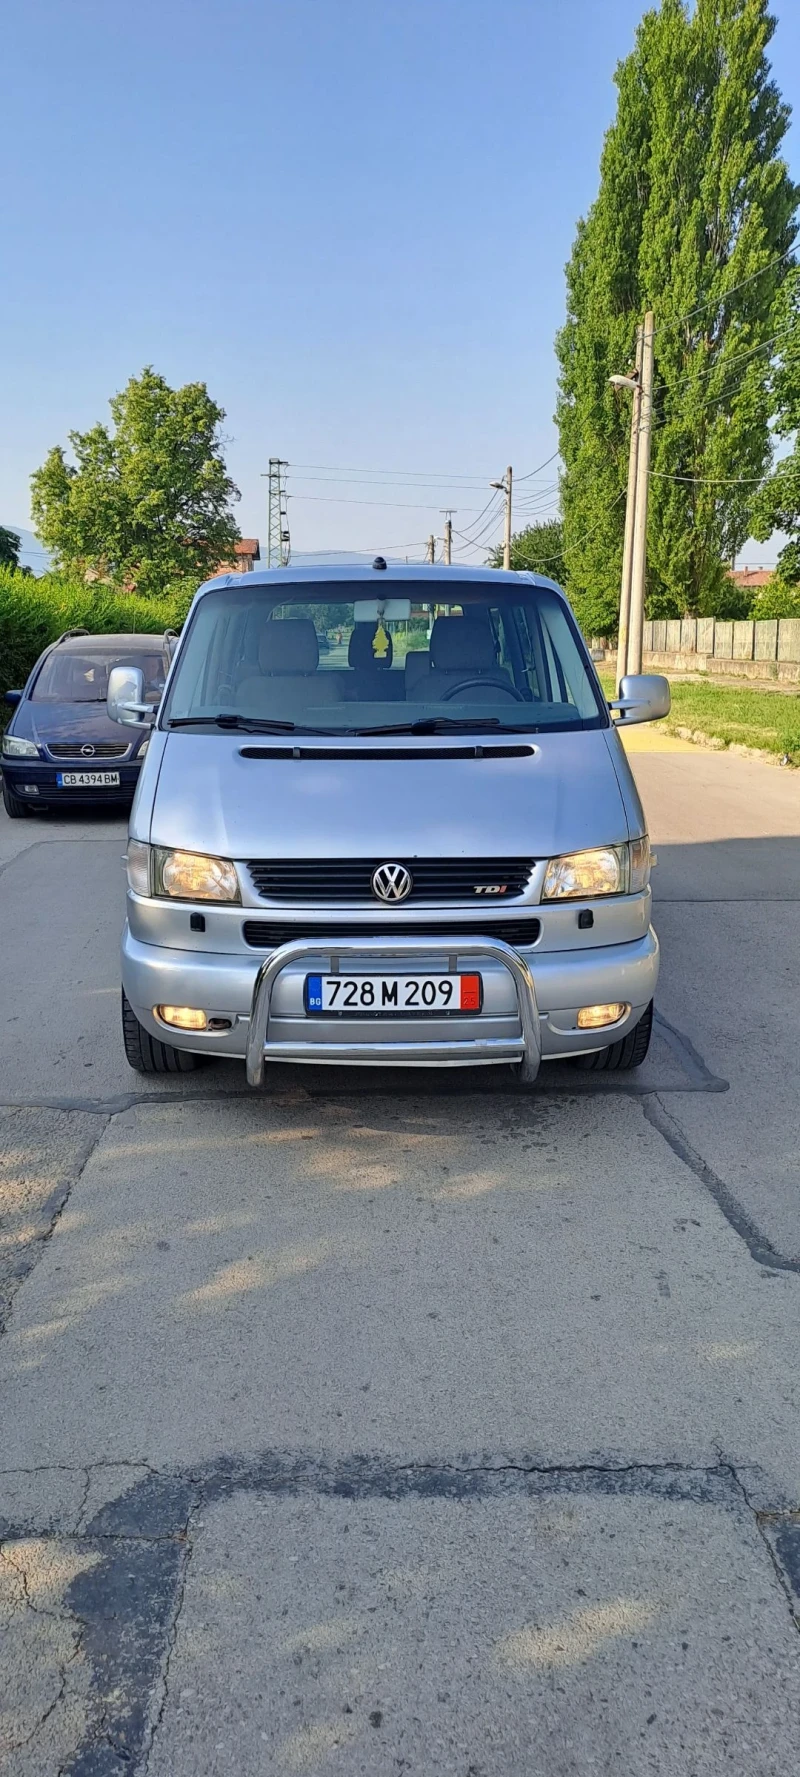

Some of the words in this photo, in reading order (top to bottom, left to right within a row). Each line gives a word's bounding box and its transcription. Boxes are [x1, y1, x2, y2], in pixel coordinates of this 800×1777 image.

[63, 774, 77, 785] CB
[78, 774, 103, 785] 4394
[104, 773, 118, 784] BM
[373, 863, 411, 901] VW
[473, 885, 507, 894] TDI
[326, 980, 375, 1006] 728
[381, 981, 398, 1006] M
[404, 980, 454, 1006] 209
[309, 997, 321, 1006] BG
